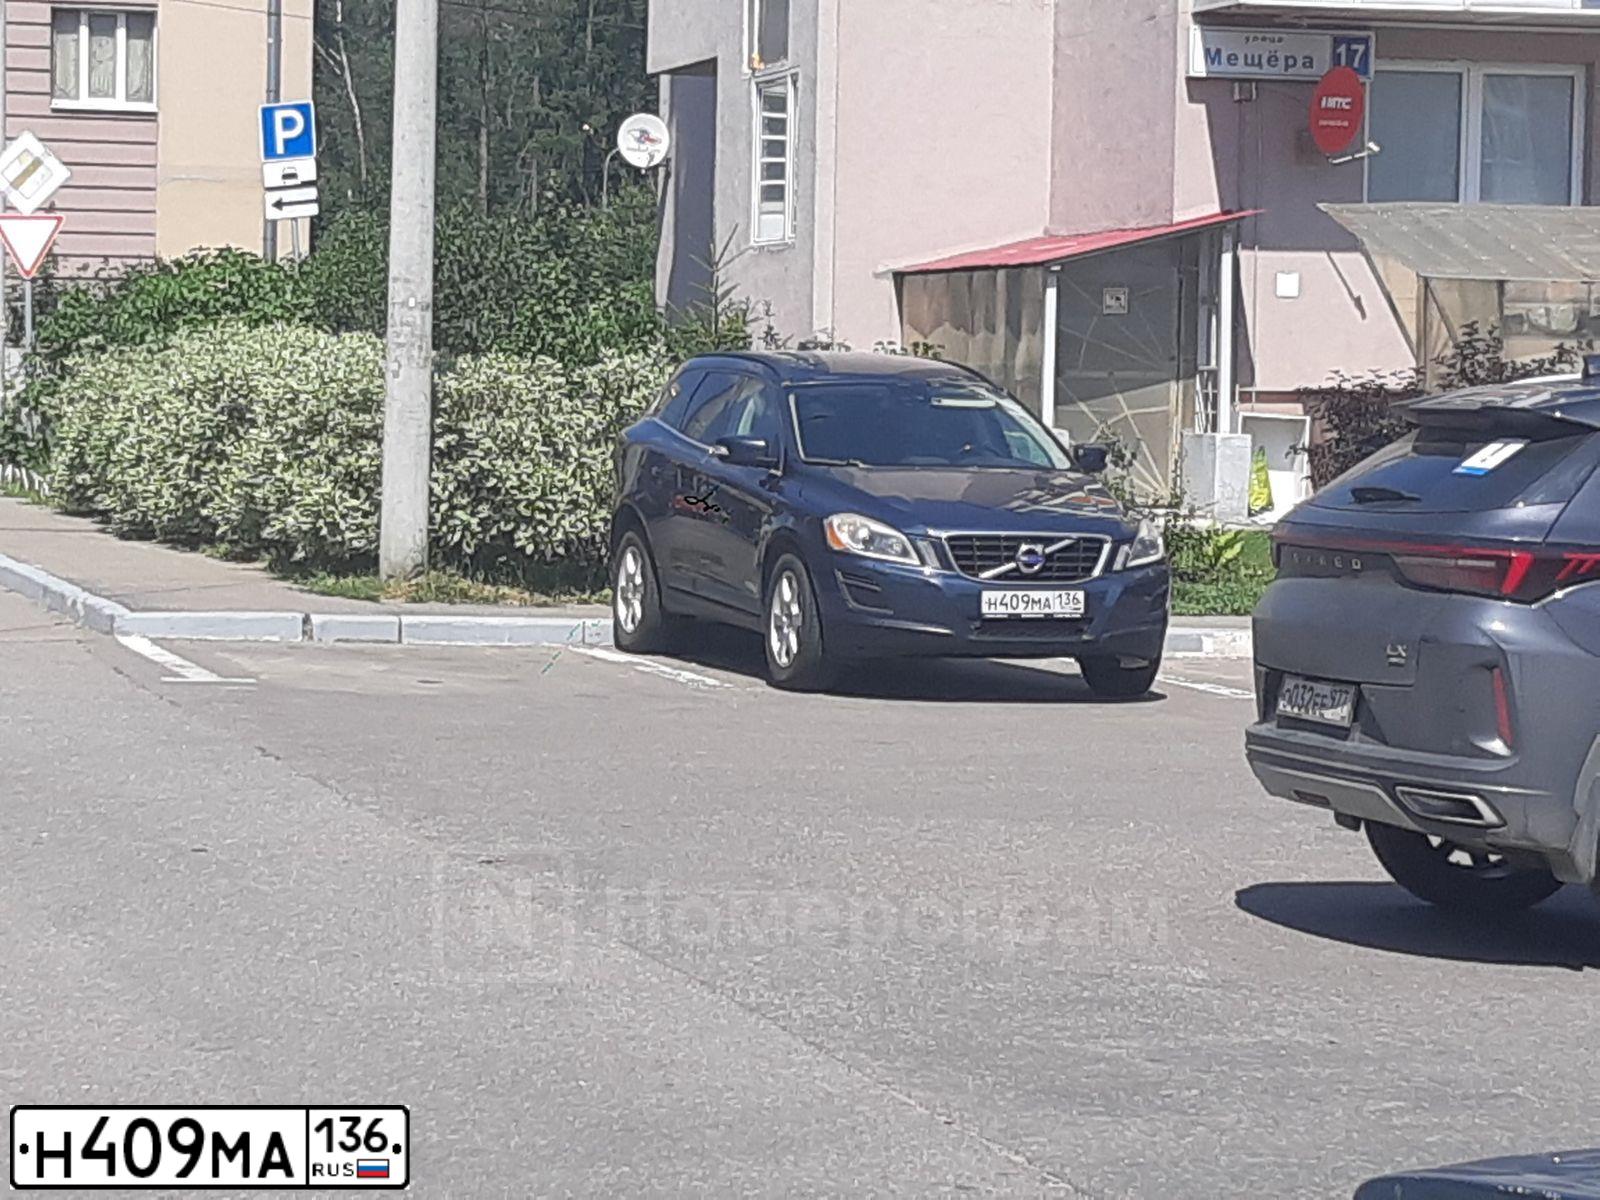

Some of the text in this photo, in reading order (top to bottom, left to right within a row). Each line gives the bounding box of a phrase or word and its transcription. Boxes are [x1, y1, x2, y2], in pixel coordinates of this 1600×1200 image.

[1205, 47, 1314, 72] Мещёра
[1335, 43, 1366, 69] 17
[274, 109, 304, 155] P
[987, 592, 1080, 611] Н409МА 136
